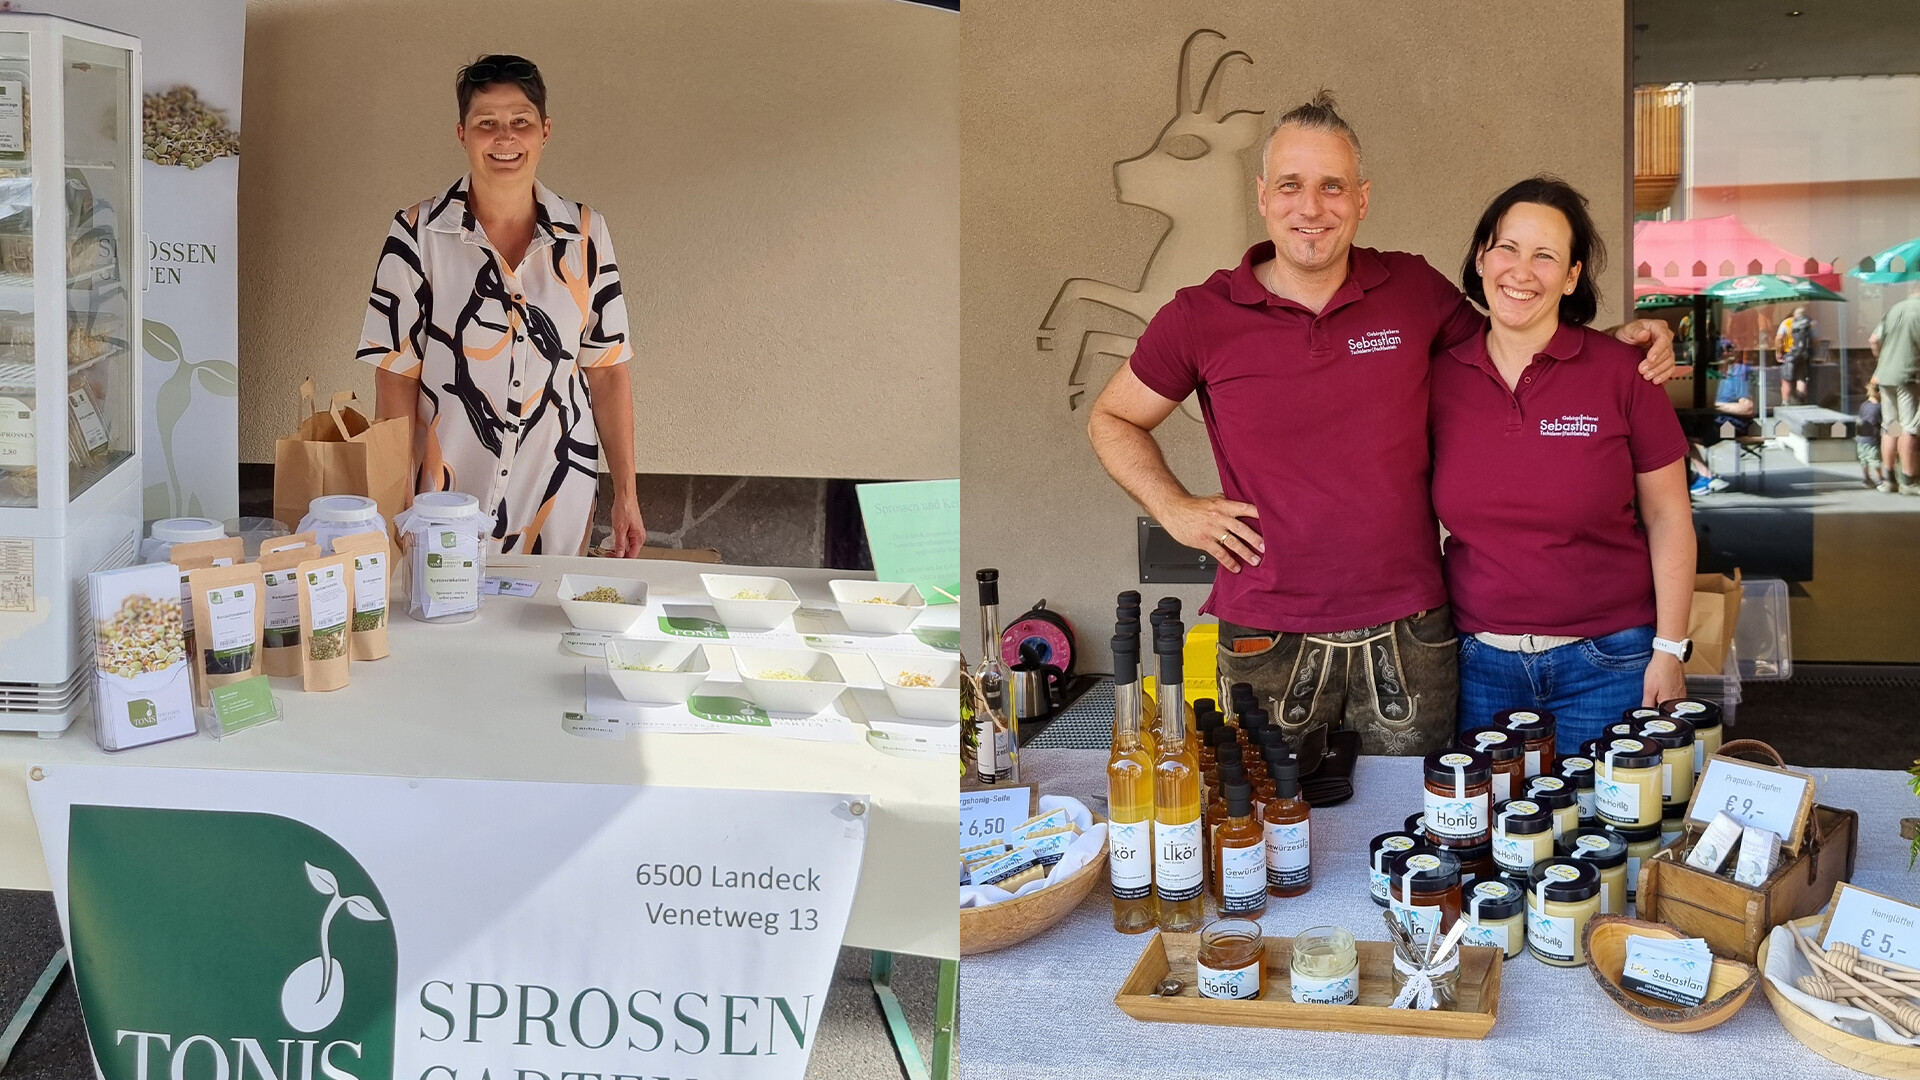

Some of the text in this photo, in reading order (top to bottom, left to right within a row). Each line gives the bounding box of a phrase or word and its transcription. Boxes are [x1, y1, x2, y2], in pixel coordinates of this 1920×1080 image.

[1539, 416, 1597, 433] Sebastian
[670, 629, 724, 638] TONIS
[133, 716, 156, 727] TONIS
[702, 713, 764, 724] TONIS
[1725, 773, 1782, 793] Propolis-Tropfen
[968, 817, 1006, 839] 6,50
[1437, 810, 1478, 829] Honig
[1110, 836, 1137, 860] ikör
[1163, 840, 1198, 861] Likör
[634, 862, 822, 894] 6500 Landeck
[644, 901, 820, 937] Venetweg 13
[1871, 908, 1915, 928] Honiglöffel
[1860, 929, 1875, 948] €
[1204, 980, 1239, 997] Honig
[417, 979, 817, 1056] SPROSSEN
[115, 1029, 364, 1080] TONIS
